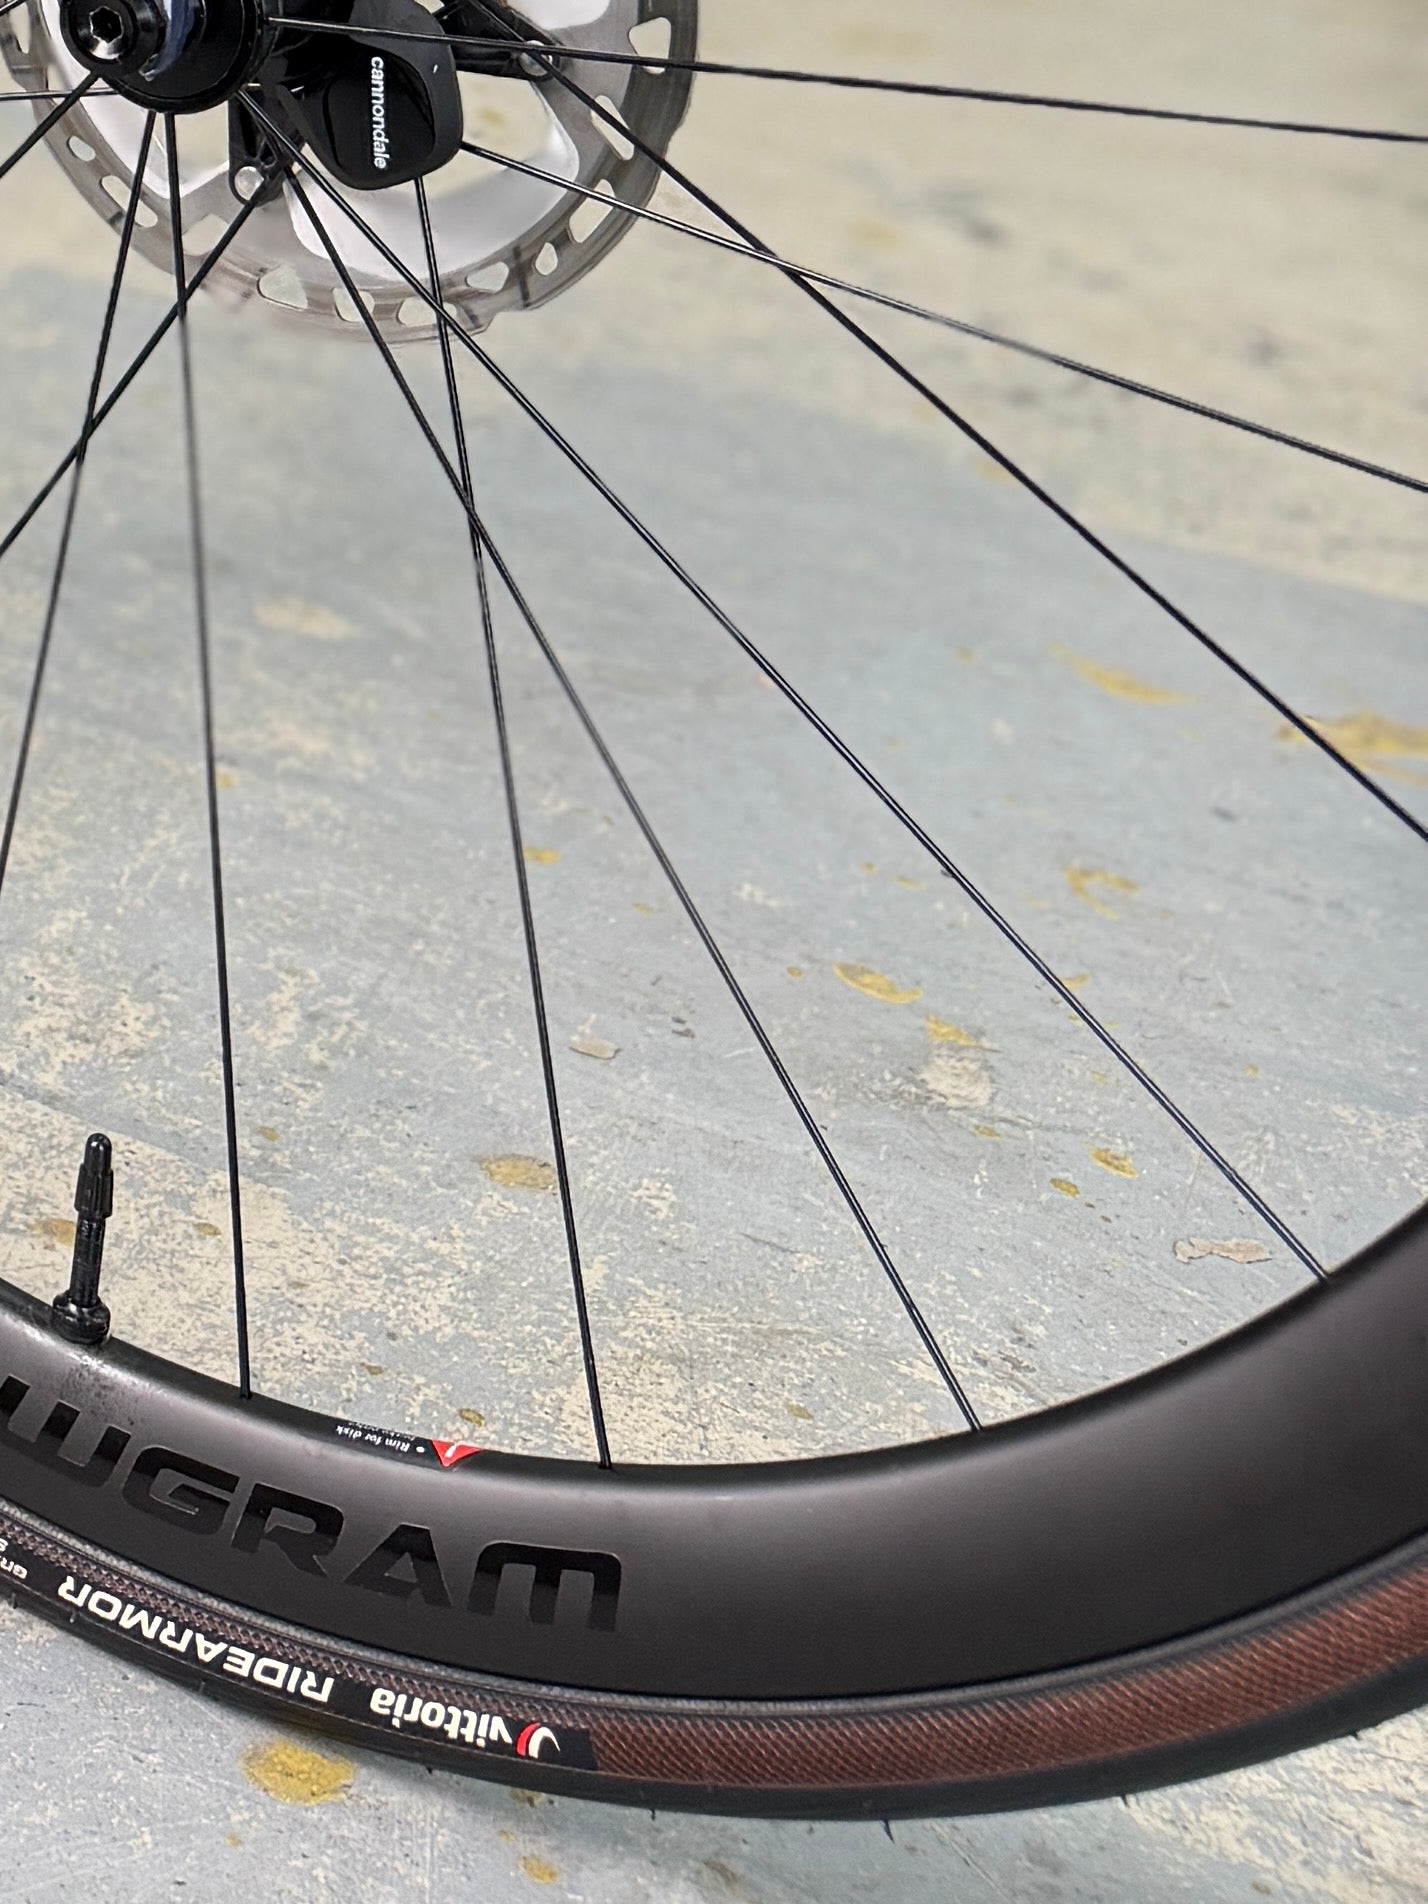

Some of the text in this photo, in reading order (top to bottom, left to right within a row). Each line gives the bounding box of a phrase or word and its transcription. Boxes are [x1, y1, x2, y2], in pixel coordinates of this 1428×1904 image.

[369, 55, 394, 170] cannondale
[364, 1432, 382, 1446] for
[385, 1437, 410, 1453] Rim
[58, 1574, 513, 1748] vittoria RIDEARMOR
